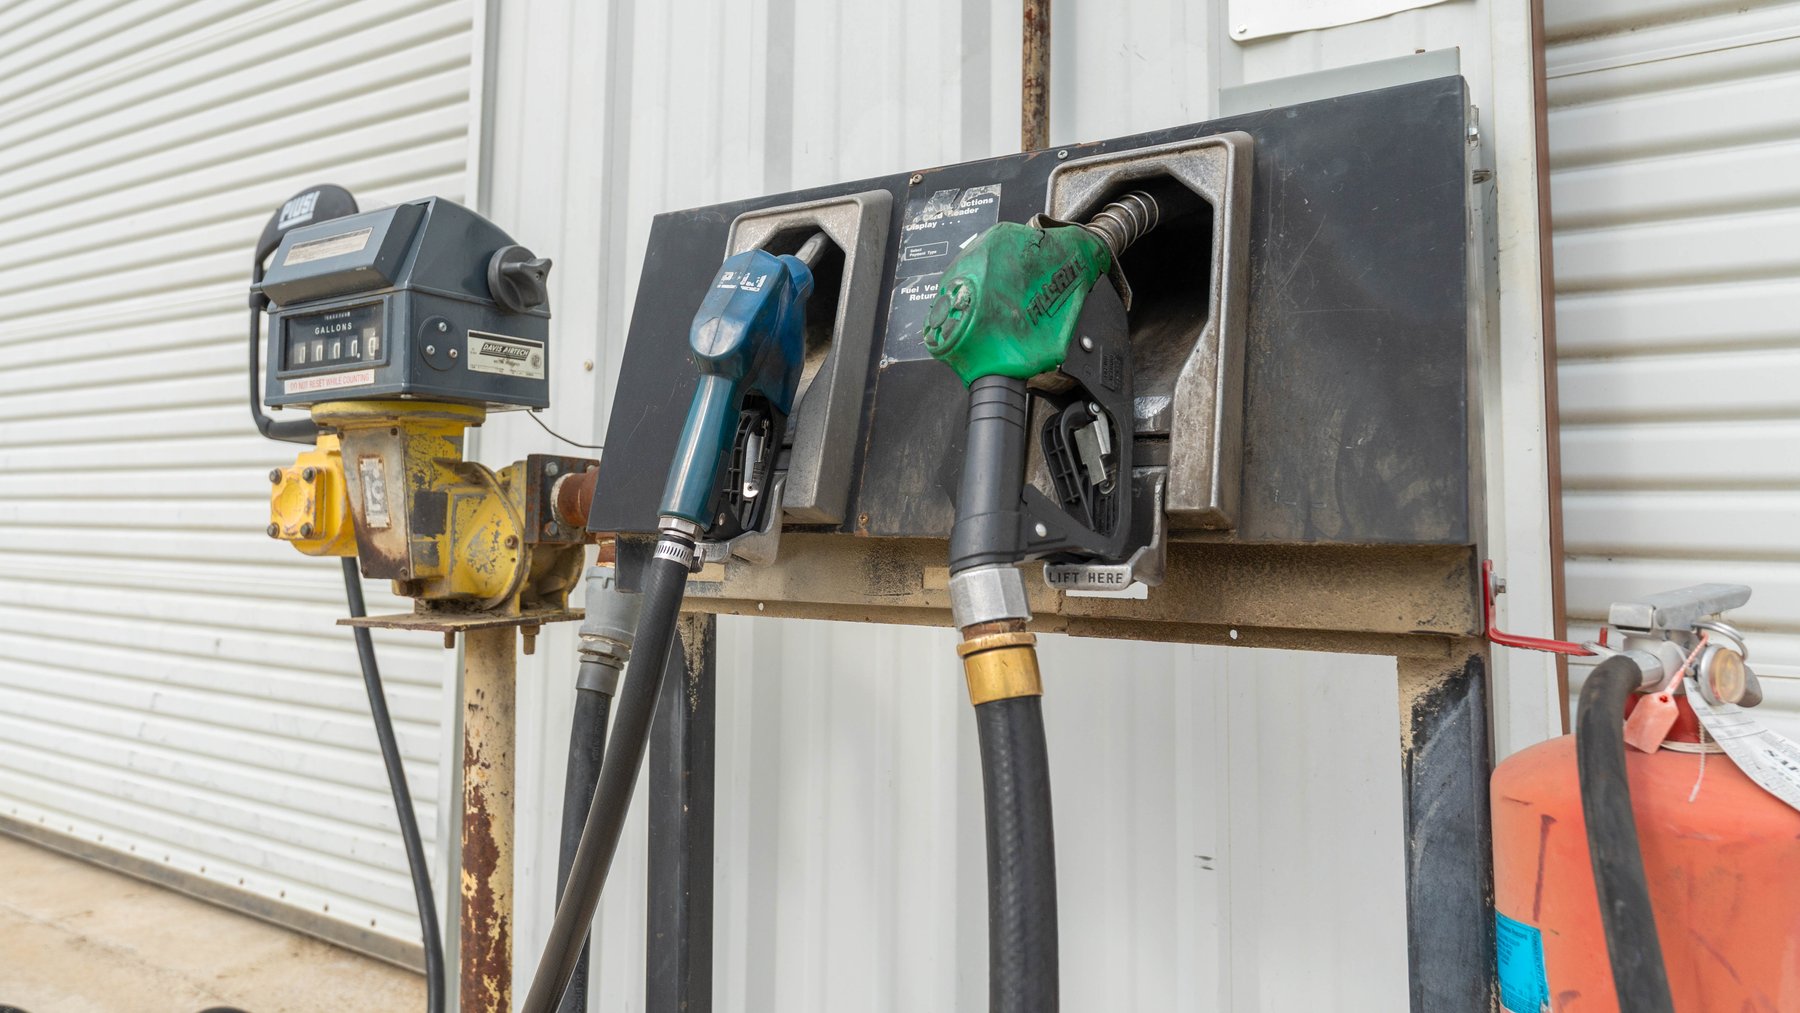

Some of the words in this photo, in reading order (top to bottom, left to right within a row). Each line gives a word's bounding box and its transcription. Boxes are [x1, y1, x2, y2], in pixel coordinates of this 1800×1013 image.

[279, 190, 320, 222] PIUSI
[905, 221, 937, 231] Display
[900, 286, 919, 294] Fuel
[314, 322, 353, 335] GALLONS
[483, 343, 502, 352] DAVIS
[503, 346, 529, 356] AIRTECH
[290, 382, 297, 391] DO
[309, 378, 325, 388] RESET
[326, 377, 342, 387] WHILE
[343, 373, 369, 385] COUNTING
[1048, 572, 1079, 583] LIFT
[1088, 572, 1123, 584] HERE
